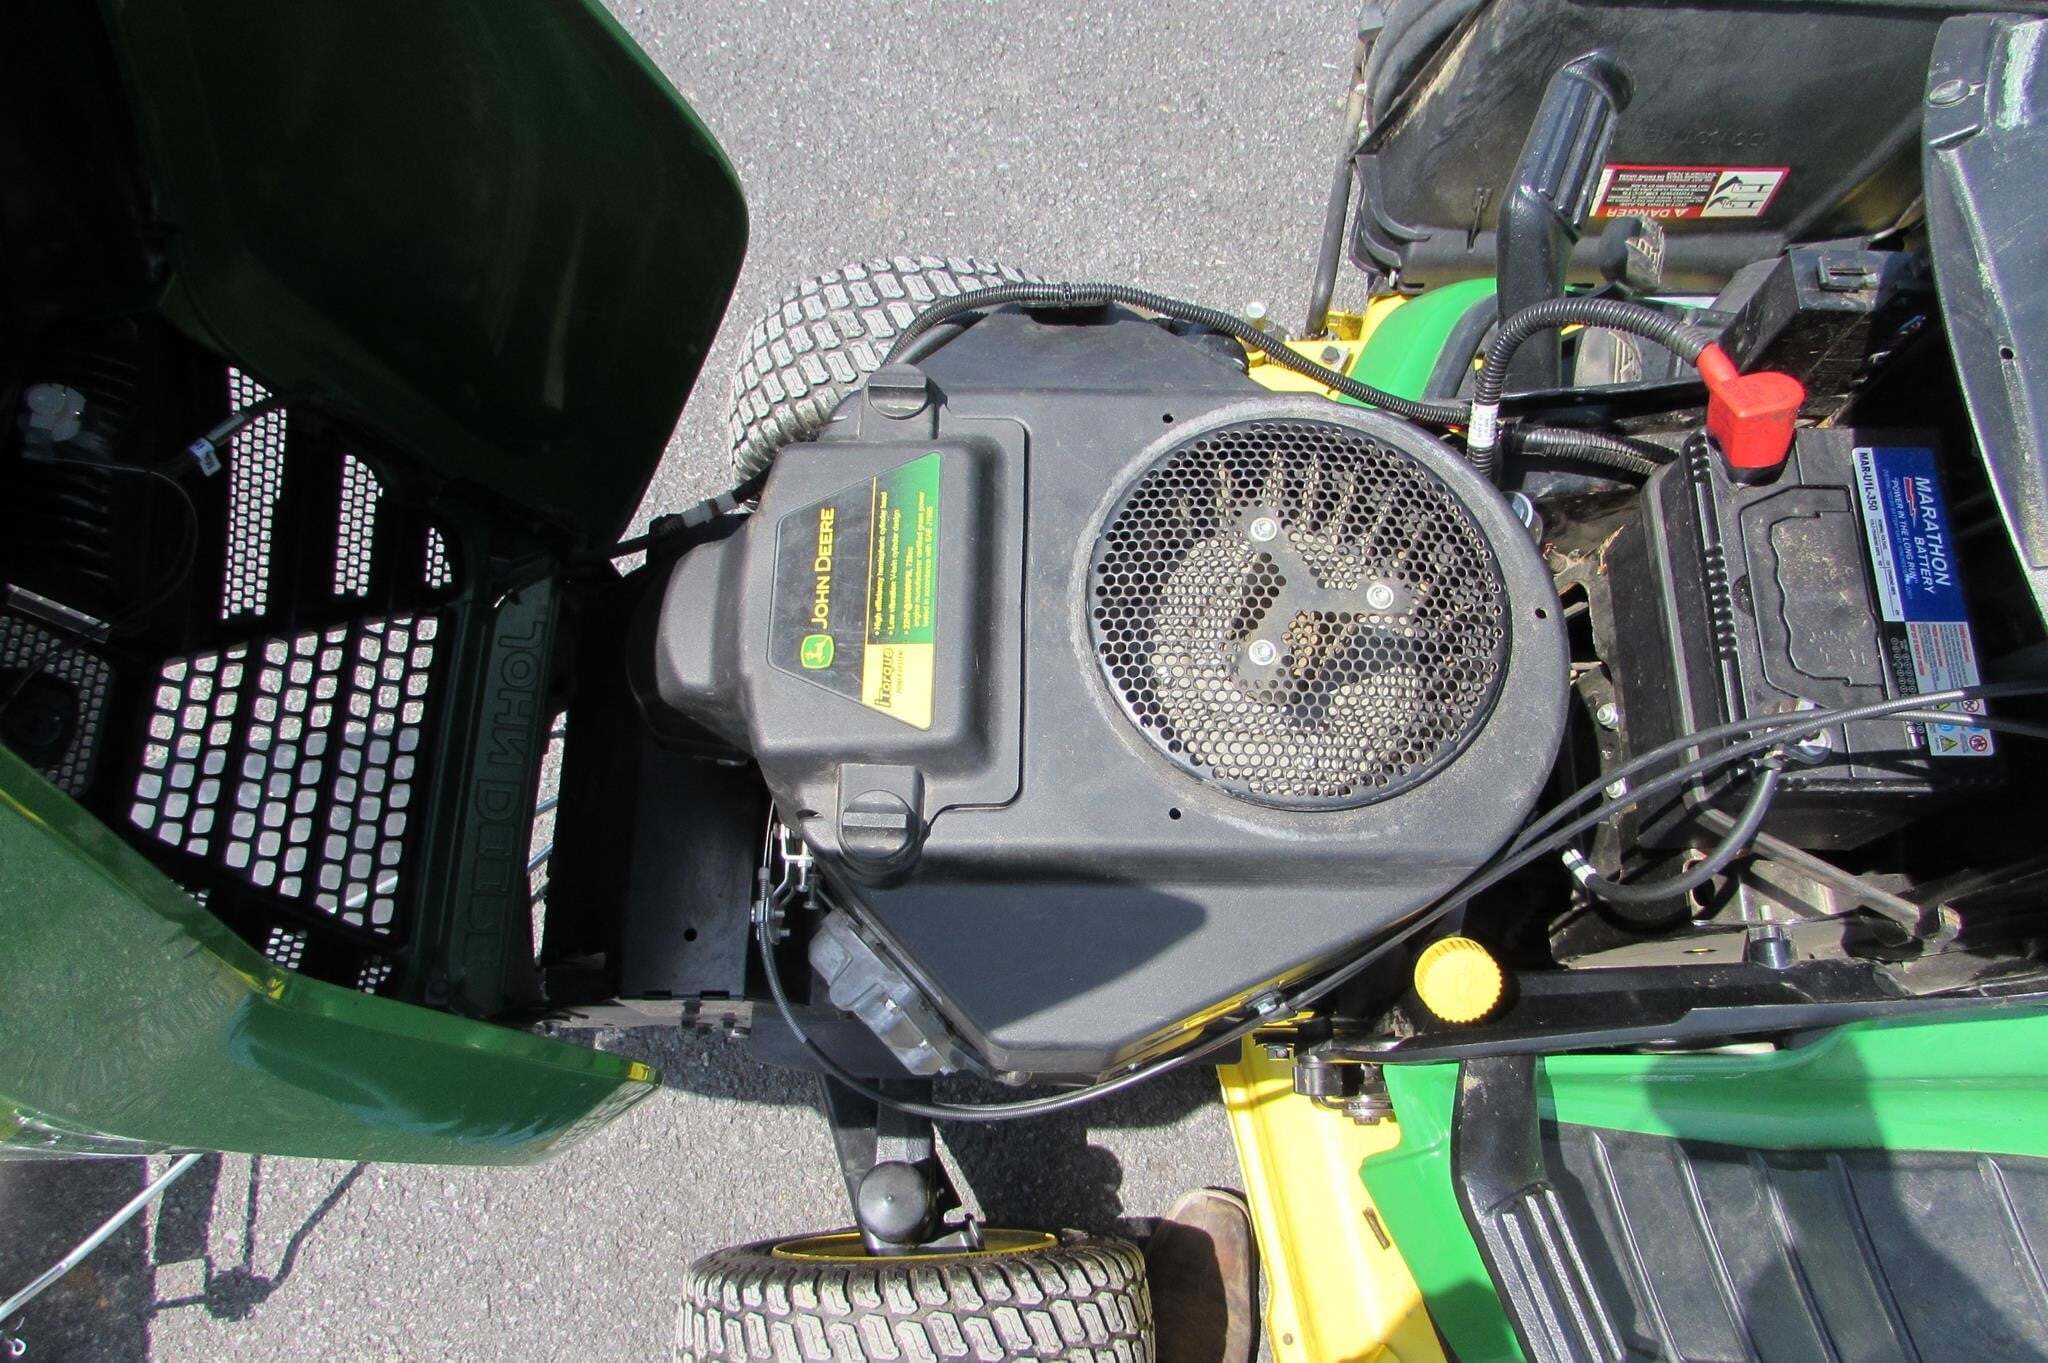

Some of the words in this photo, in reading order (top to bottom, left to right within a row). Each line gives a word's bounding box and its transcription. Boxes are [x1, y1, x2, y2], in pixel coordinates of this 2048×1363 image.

[1606, 208, 1671, 217] DANGER
[1859, 452, 1878, 511] MAR-U1L-350
[893, 509, 901, 531] design
[1898, 511, 1907, 519] IN
[1900, 521, 1909, 536] THE
[1915, 477, 1951, 585] MARATHON
[815, 507, 835, 572] DEERE
[1902, 538, 1913, 560] LONG
[1914, 537, 1934, 594] BATTERY
[812, 575, 831, 629] JOHN
[875, 577, 885, 612] efficiency
[873, 613, 882, 630] High
[874, 648, 894, 707] iTorque
